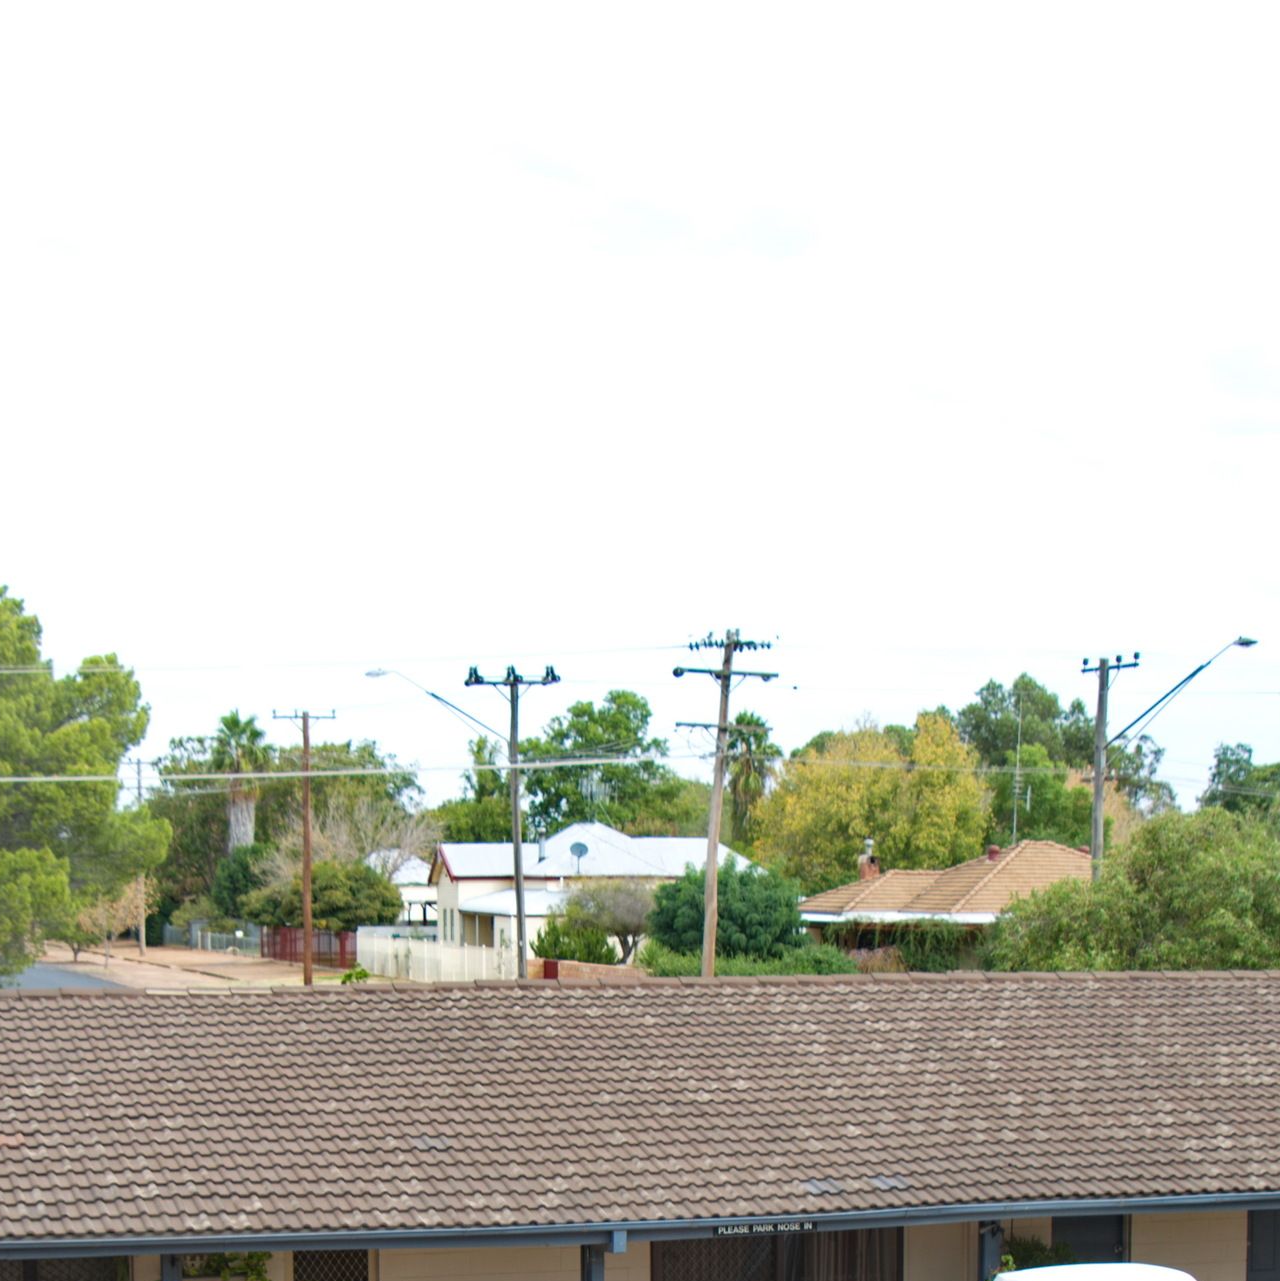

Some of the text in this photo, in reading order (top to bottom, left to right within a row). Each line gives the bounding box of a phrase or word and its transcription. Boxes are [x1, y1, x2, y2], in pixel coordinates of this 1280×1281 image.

[718, 1221, 813, 1235] PLEASE PARK NOSE IN
